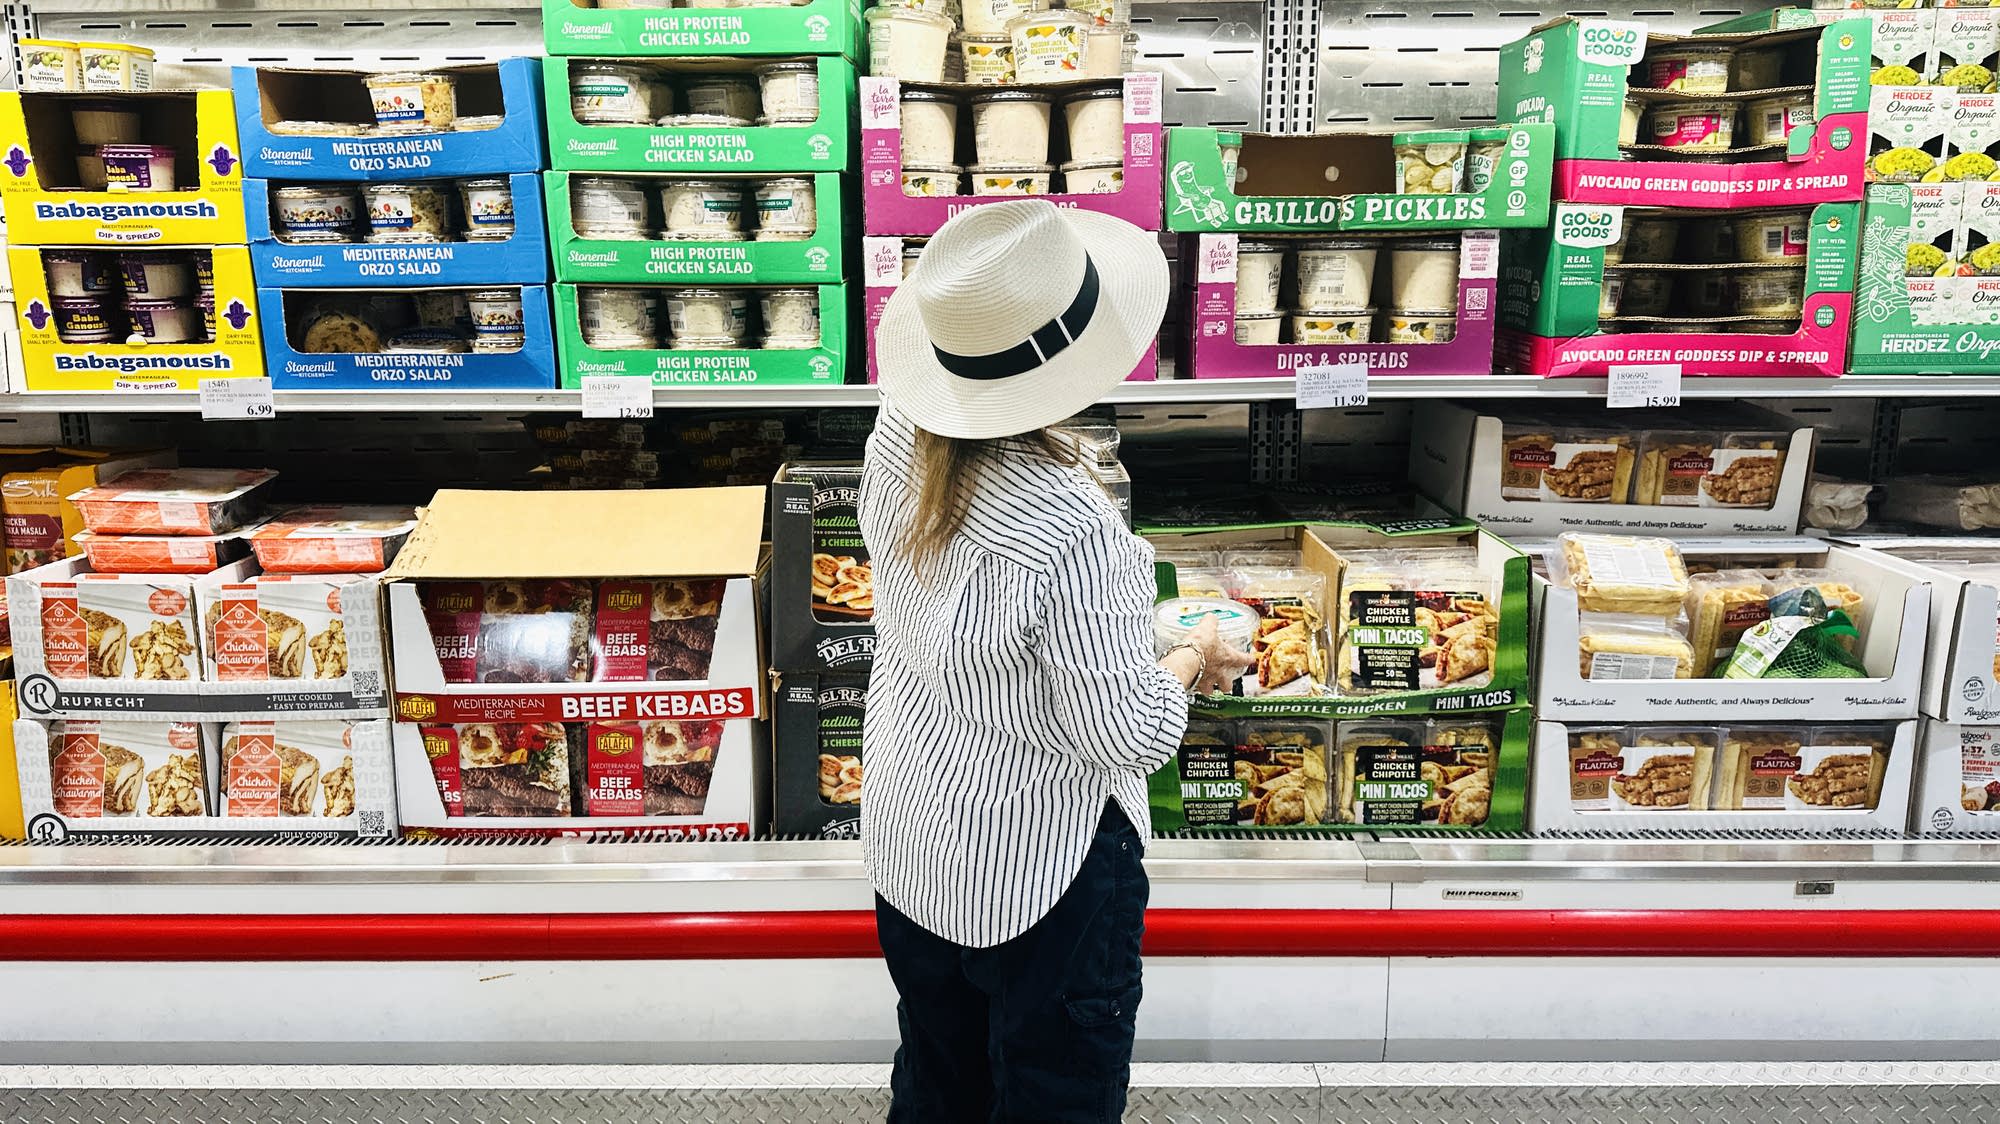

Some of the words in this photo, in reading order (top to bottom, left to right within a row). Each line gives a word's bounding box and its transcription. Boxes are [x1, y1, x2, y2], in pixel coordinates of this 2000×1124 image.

[561, 22, 614, 36] Stonemill
[644, 17, 679, 30] HIGH
[684, 16, 742, 30] PROTEIN
[1951, 22, 1993, 36] Organic
[1584, 28, 1637, 44] GOOD
[1878, 23, 1919, 37] Organic
[639, 32, 700, 46] CHICKEN
[704, 31, 750, 45] SALAD
[1584, 44, 1633, 58] FOODS
[1588, 74, 1613, 82] REAL
[1893, 92, 1933, 100] HERDEZ
[1886, 101, 1935, 118] Organic
[1954, 108, 1996, 123] Organic
[567, 139, 617, 152] Stonemill
[1516, 134, 1525, 146] 5
[260, 147, 313, 161] Stonemill
[332, 139, 443, 156] MEDITERRANEAN
[350, 157, 384, 170] ORZO
[387, 156, 431, 170] SALAD
[1511, 166, 1526, 174] GF
[1579, 175, 1641, 190] AVOCADO
[1645, 177, 1688, 192] GREEN
[1691, 178, 1753, 192] GODDESS
[1758, 178, 1780, 192] DIP
[1783, 177, 1792, 190] &
[1796, 175, 1848, 189] SPREAD
[37, 202, 216, 220] Babaganoush
[1235, 201, 1354, 225] GRILLO'S
[1365, 198, 1484, 221] PICKLES
[1562, 212, 1612, 227] GOOD
[126, 232, 161, 240] SPREAD
[1562, 226, 1610, 240] FOODS
[1218, 241, 1226, 250] la
[343, 247, 453, 262] MEDITERRANEAN
[568, 251, 618, 262] Stonemill
[650, 248, 684, 260] HIGH
[688, 247, 746, 259] PROTEIN
[1210, 249, 1232, 258] terra
[1566, 256, 1591, 264] REAL
[272, 256, 323, 270] Stonemill
[359, 264, 394, 276] ORZO
[398, 261, 441, 275] SALAD
[645, 262, 704, 273] CHICKEN
[708, 262, 753, 273] SALAD
[1211, 258, 1230, 273] fina
[1881, 339, 1950, 353] HERDEZ
[56, 354, 230, 371] Babaganoush
[354, 355, 463, 368] MEDITERRANEAN
[657, 356, 690, 369] HIGH
[694, 356, 750, 368] PROTEIN
[1277, 353, 1312, 369] DIPS
[1319, 352, 1330, 366] &
[1339, 352, 1408, 368] SPREADS
[1562, 351, 1623, 362] AVOCADO
[1628, 350, 1670, 361] GREEN
[1675, 350, 1735, 362] GODDESS
[1739, 351, 1763, 363] DIP
[1766, 352, 1775, 362] &
[1778, 352, 1829, 364] SPREAD
[285, 360, 336, 374] Stonemill
[576, 360, 626, 373] Stonemill
[371, 368, 406, 381] ORZO
[409, 368, 452, 381] SALAD
[652, 370, 709, 382] CHICKEN
[713, 370, 757, 382] SALAD
[143, 381, 177, 390] SPREAD
[1335, 395, 1365, 406] 11.99
[1646, 396, 1676, 407] 15.99
[247, 404, 272, 415] 6.99
[620, 408, 650, 418] 12.99
[1514, 454, 1550, 462] FLAUTAS
[1674, 461, 1709, 469] FLAUTAS
[21, 527, 47, 535] MASALA
[1643, 520, 1668, 529] Always
[607, 634, 638, 645] BEEF
[1354, 629, 1380, 644] MINI
[1383, 630, 1424, 644] TACOS
[225, 641, 258, 652] Chicken
[218, 654, 266, 665] Shawarma
[62, 697, 145, 708] RUPRECHT
[454, 698, 545, 709] MEDITERRANEAN
[562, 696, 627, 718] BEEF
[635, 692, 744, 716] KEBABS
[1436, 696, 1464, 709] MINI
[1471, 690, 1512, 707] TACOS
[1740, 698, 1769, 706] Always
[400, 701, 436, 715] FALAFEL
[484, 708, 516, 719] RECIPE
[1252, 705, 1330, 716] CHIPOTLE
[1336, 701, 1406, 715] CHICKEN
[598, 736, 633, 751] FALAFEL
[1580, 762, 1618, 770] FLAUTAS
[1756, 760, 1795, 769] FLAUTAS
[600, 778, 632, 788] BEEF
[590, 789, 642, 800] KEBABS
[1360, 784, 1386, 798] MINI
[1389, 784, 1428, 798] TACOS
